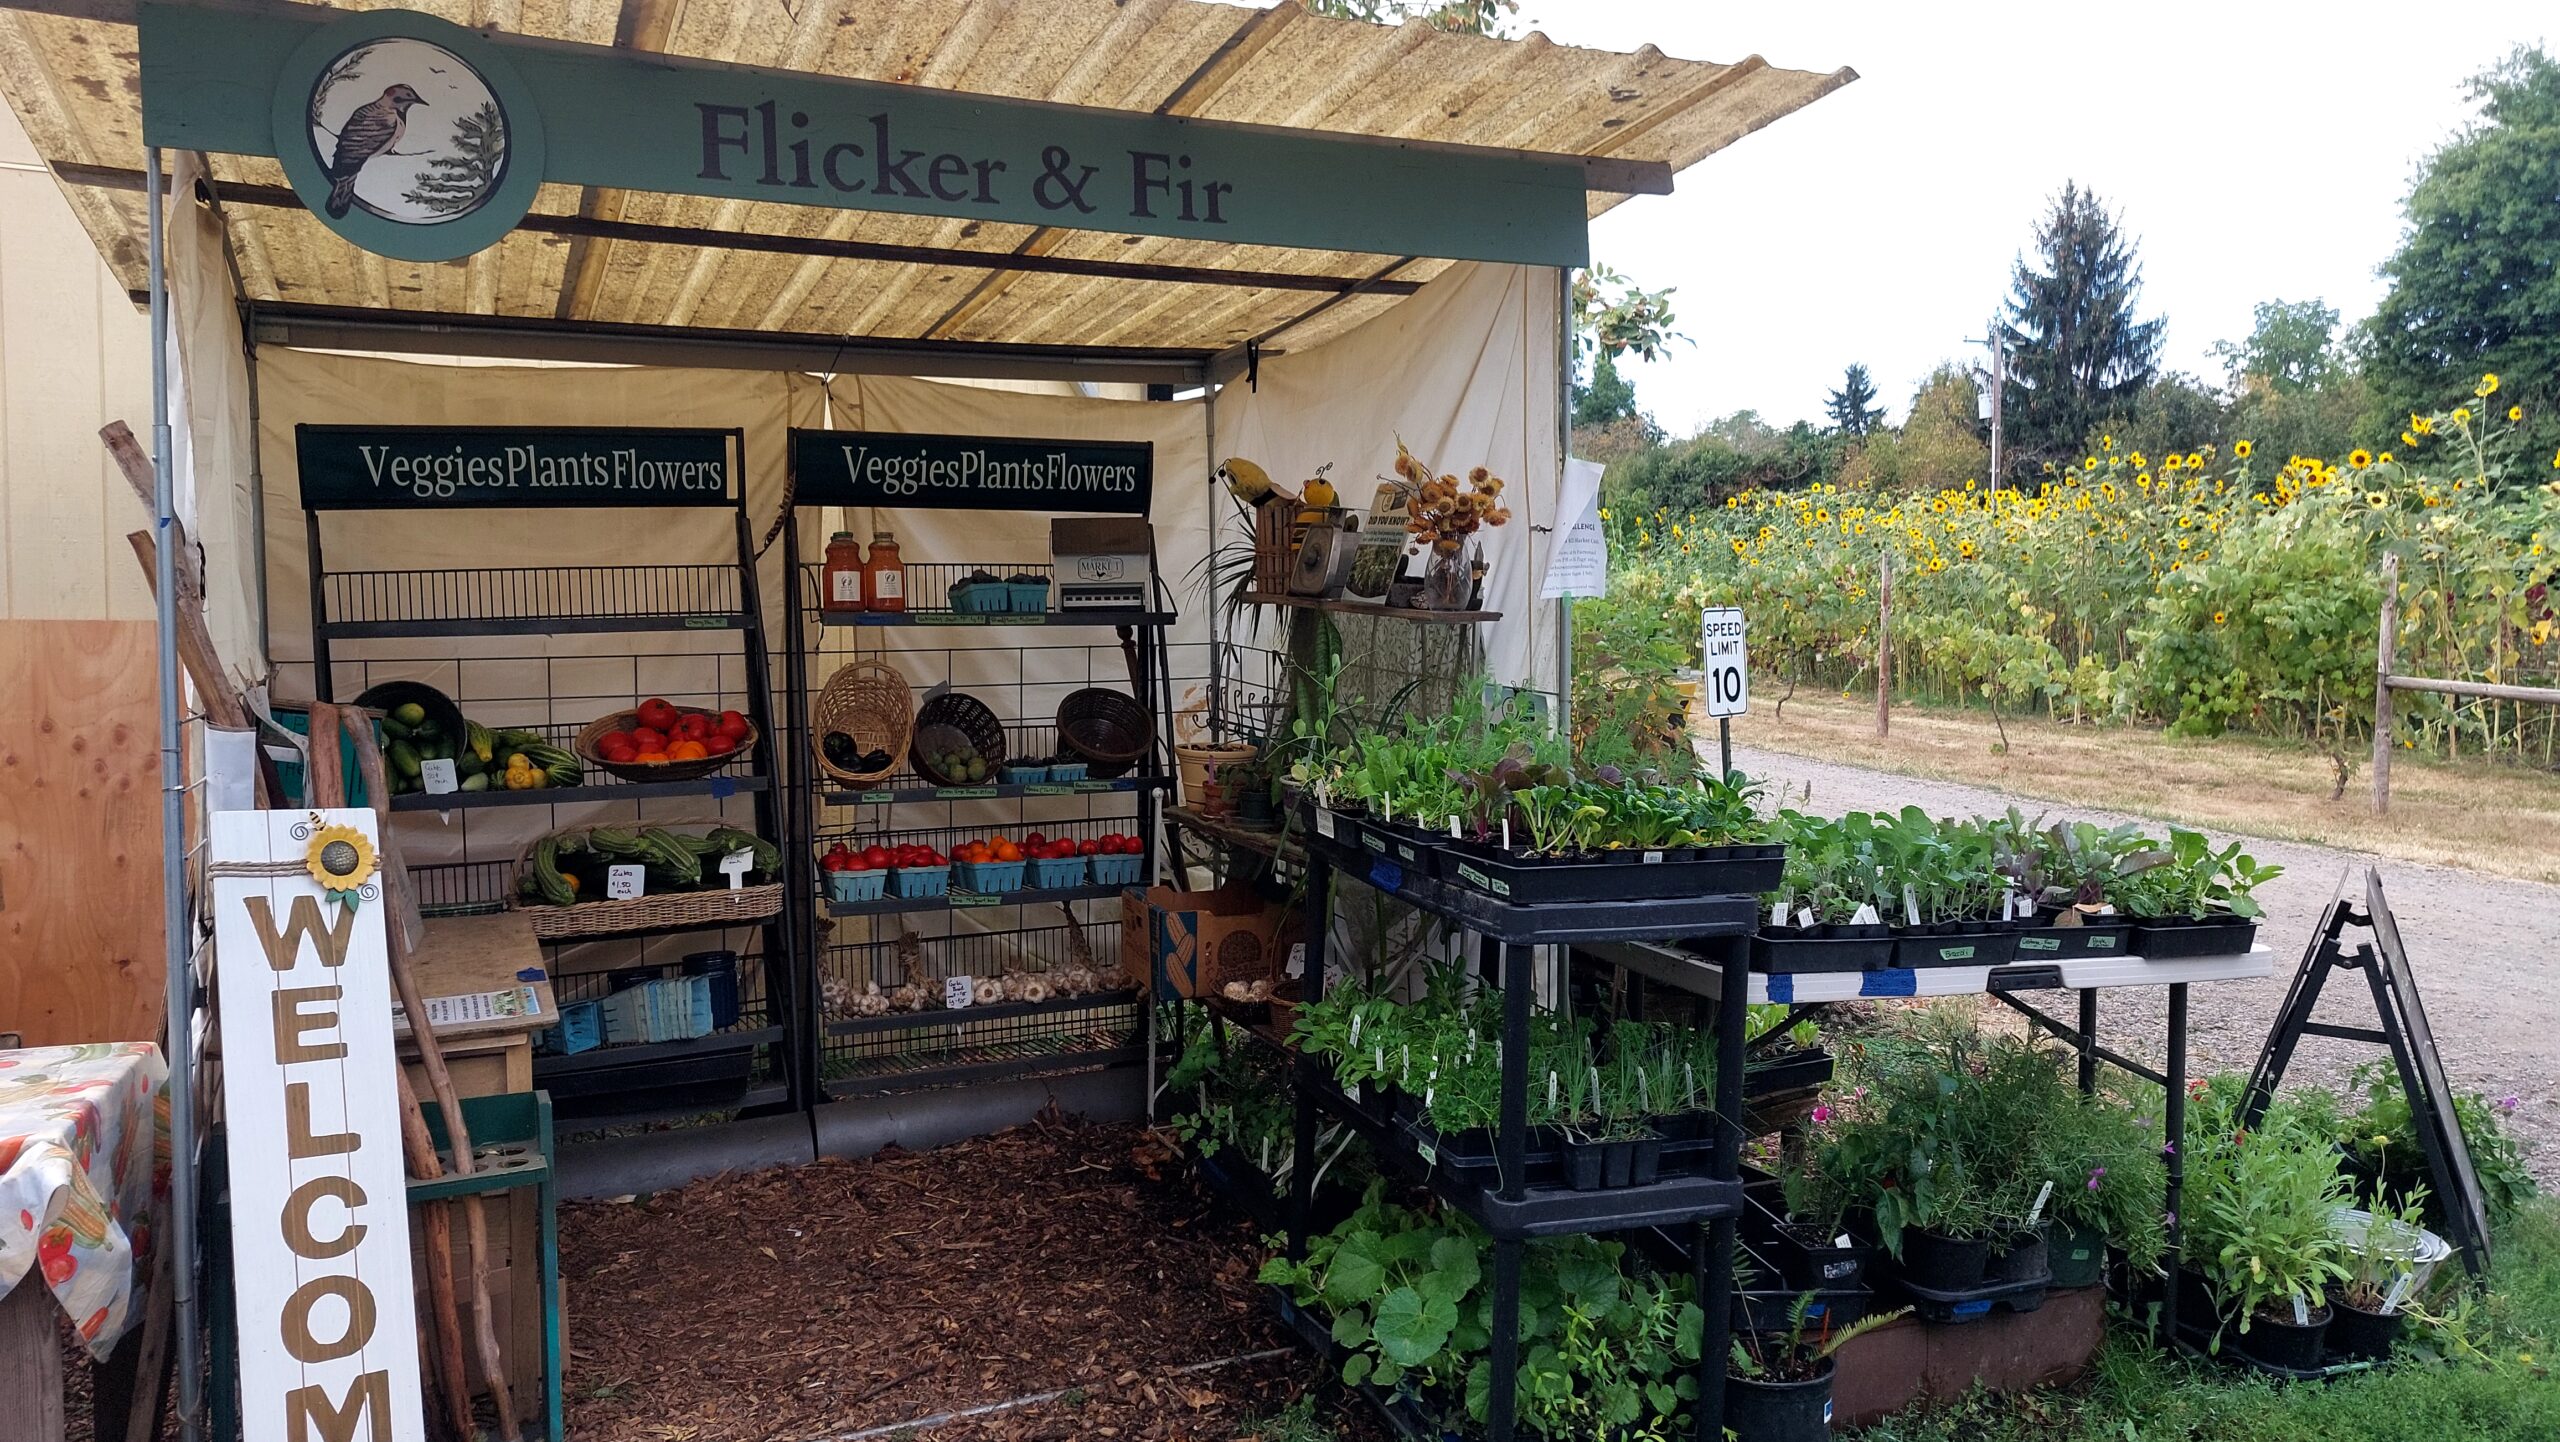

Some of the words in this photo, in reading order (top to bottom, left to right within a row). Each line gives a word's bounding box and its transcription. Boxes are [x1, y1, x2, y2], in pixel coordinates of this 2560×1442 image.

[694, 100, 1007, 204] Flicker
[1033, 146, 1099, 214] &
[1127, 150, 1233, 223] Fir
[1706, 622, 1741, 638] SPEED
[1710, 641, 1739, 656] LIMIT
[1713, 666, 1741, 703] 10
